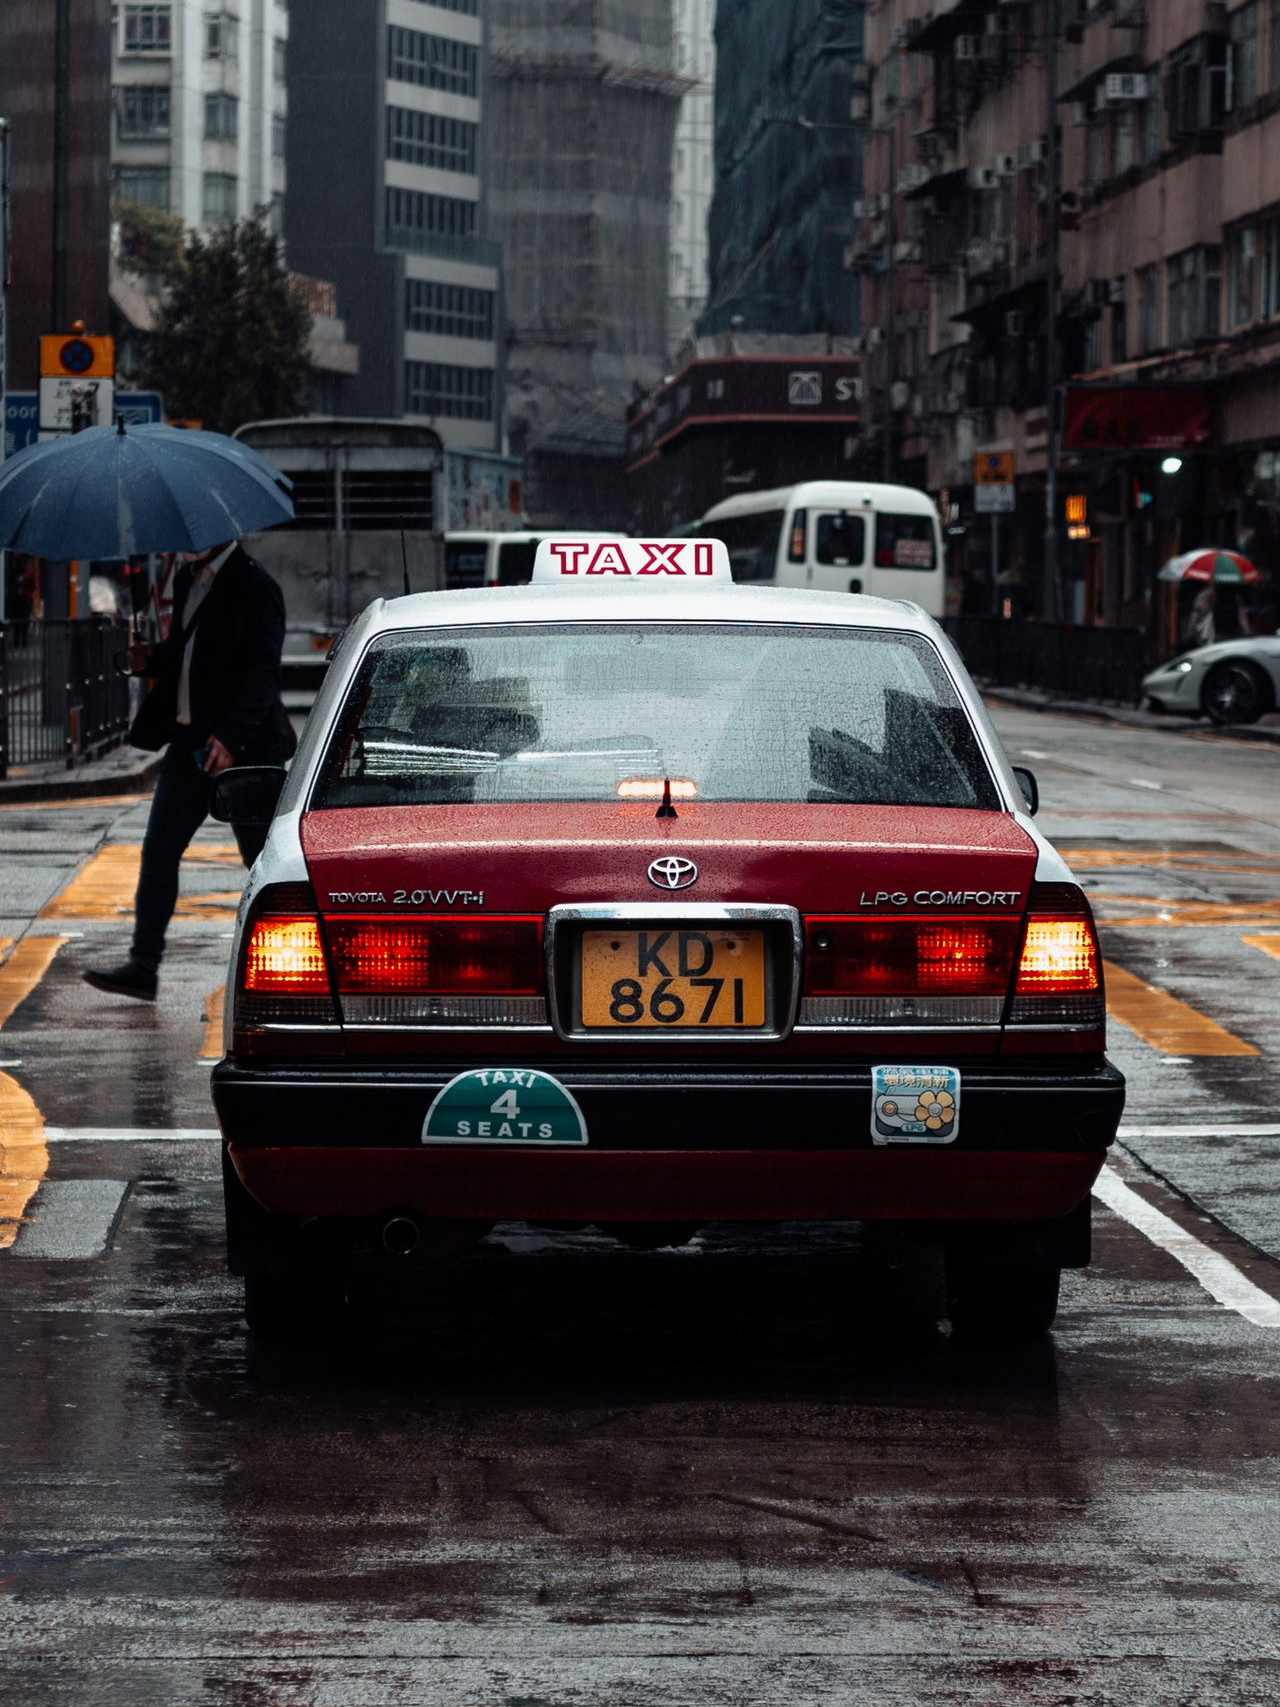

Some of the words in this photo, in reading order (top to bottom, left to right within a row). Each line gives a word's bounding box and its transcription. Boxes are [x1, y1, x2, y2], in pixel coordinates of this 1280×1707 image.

[550, 542, 713, 576] TAXI
[328, 892, 387, 904] TOYOTA
[859, 891, 908, 906] LPG
[913, 890, 1021, 906] COMFORT
[637, 931, 714, 978] KD
[608, 978, 744, 1024] 8671
[475, 1071, 537, 1089] TAXI
[490, 1089, 520, 1120] 4
[457, 1121, 553, 1138] SEATS
